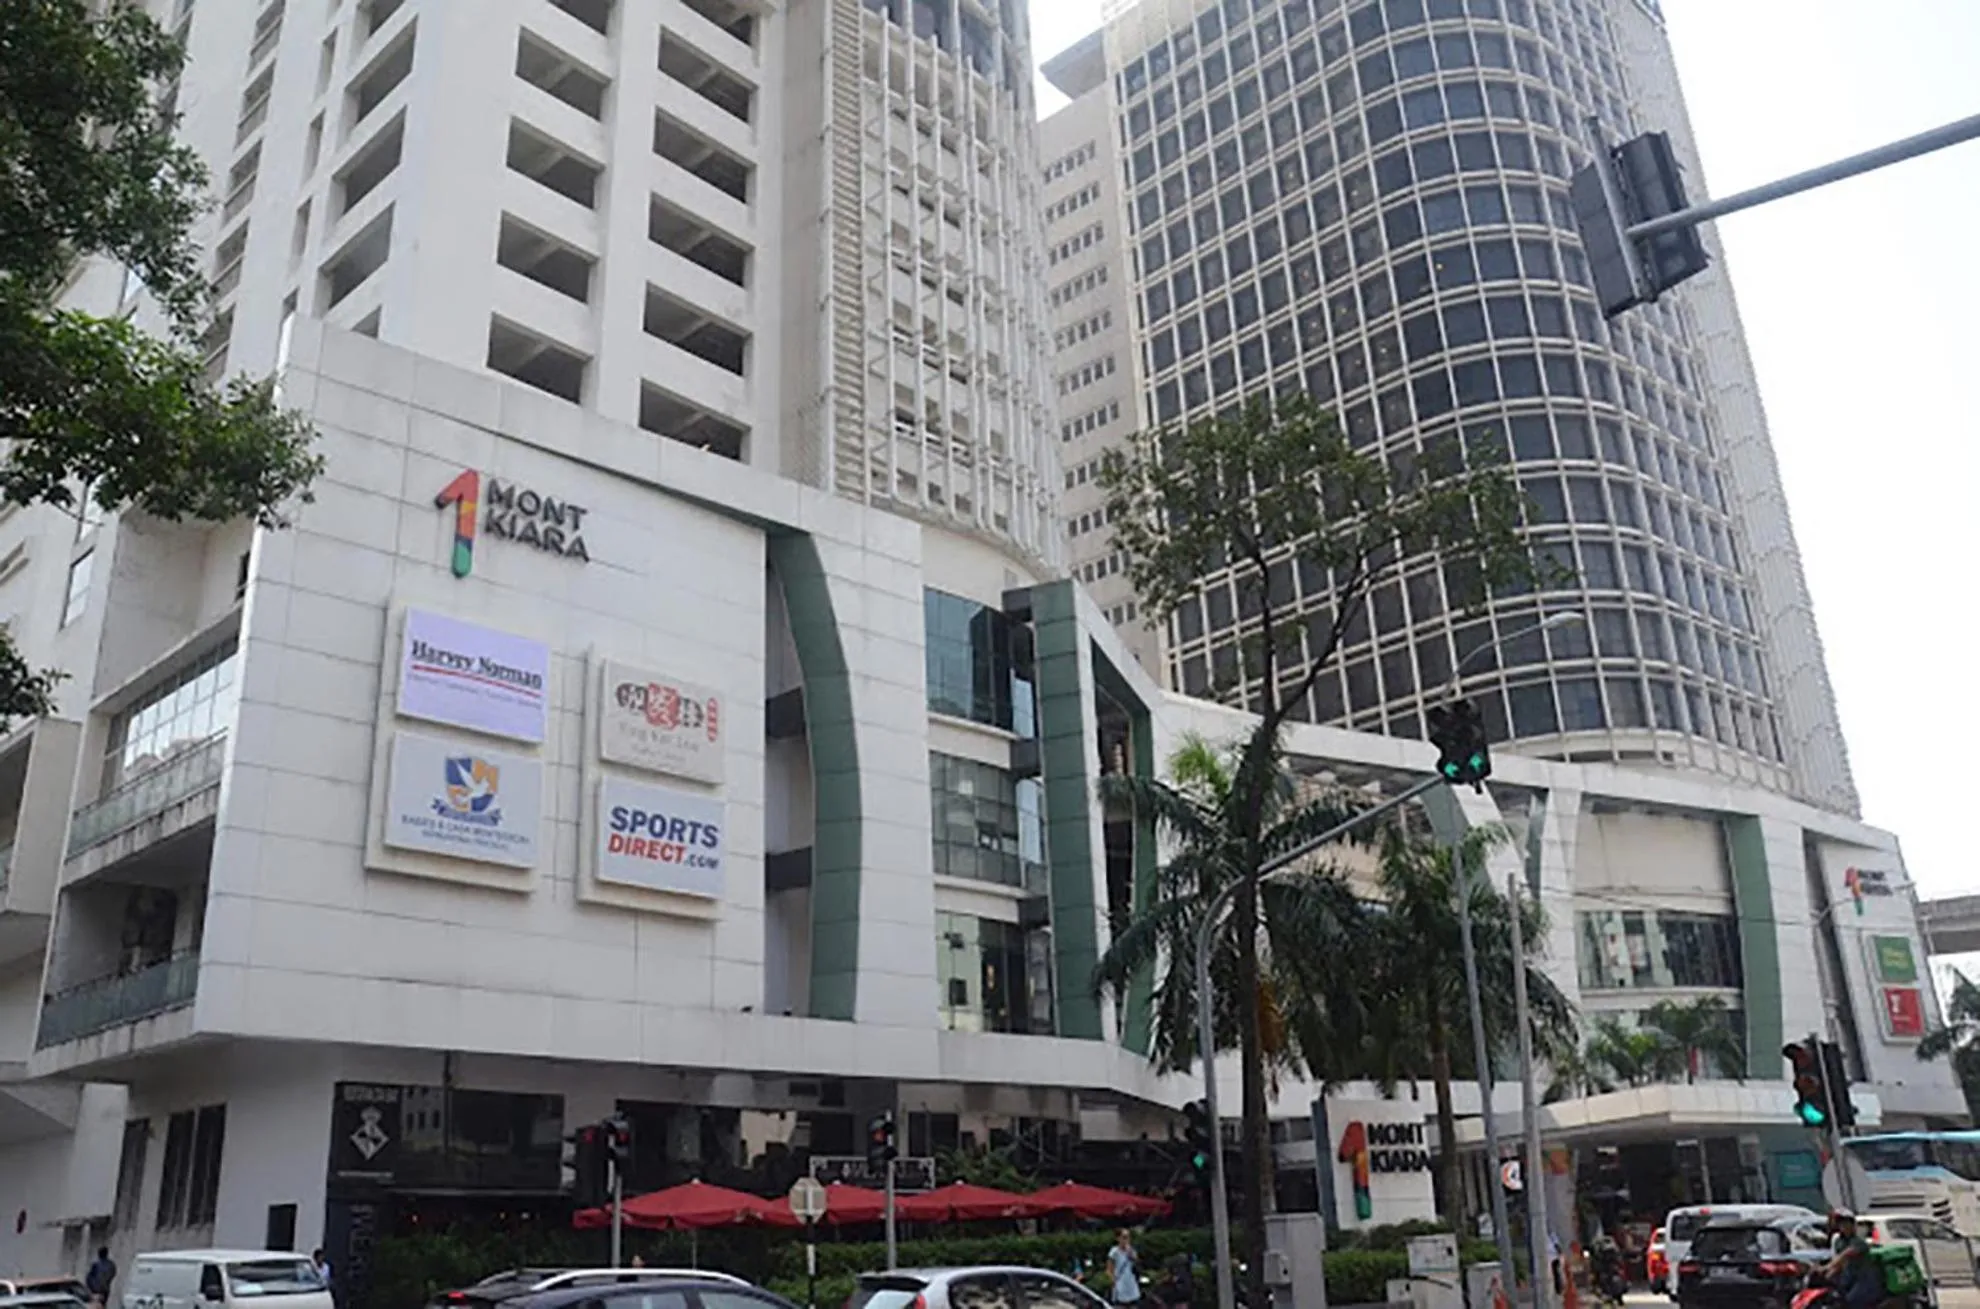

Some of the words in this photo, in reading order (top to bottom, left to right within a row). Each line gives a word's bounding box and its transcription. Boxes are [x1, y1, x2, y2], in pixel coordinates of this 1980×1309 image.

[434, 467, 480, 580] 1
[487, 479, 588, 531] MONT
[484, 508, 591, 563] KIARA
[411, 639, 476, 671] Harvey
[478, 655, 543, 690] Norman
[610, 806, 720, 849] SPORTS
[1338, 1120, 1373, 1221] 1
[1367, 1122, 1424, 1146] MONT
[1369, 1149, 1434, 1173] KIARA
